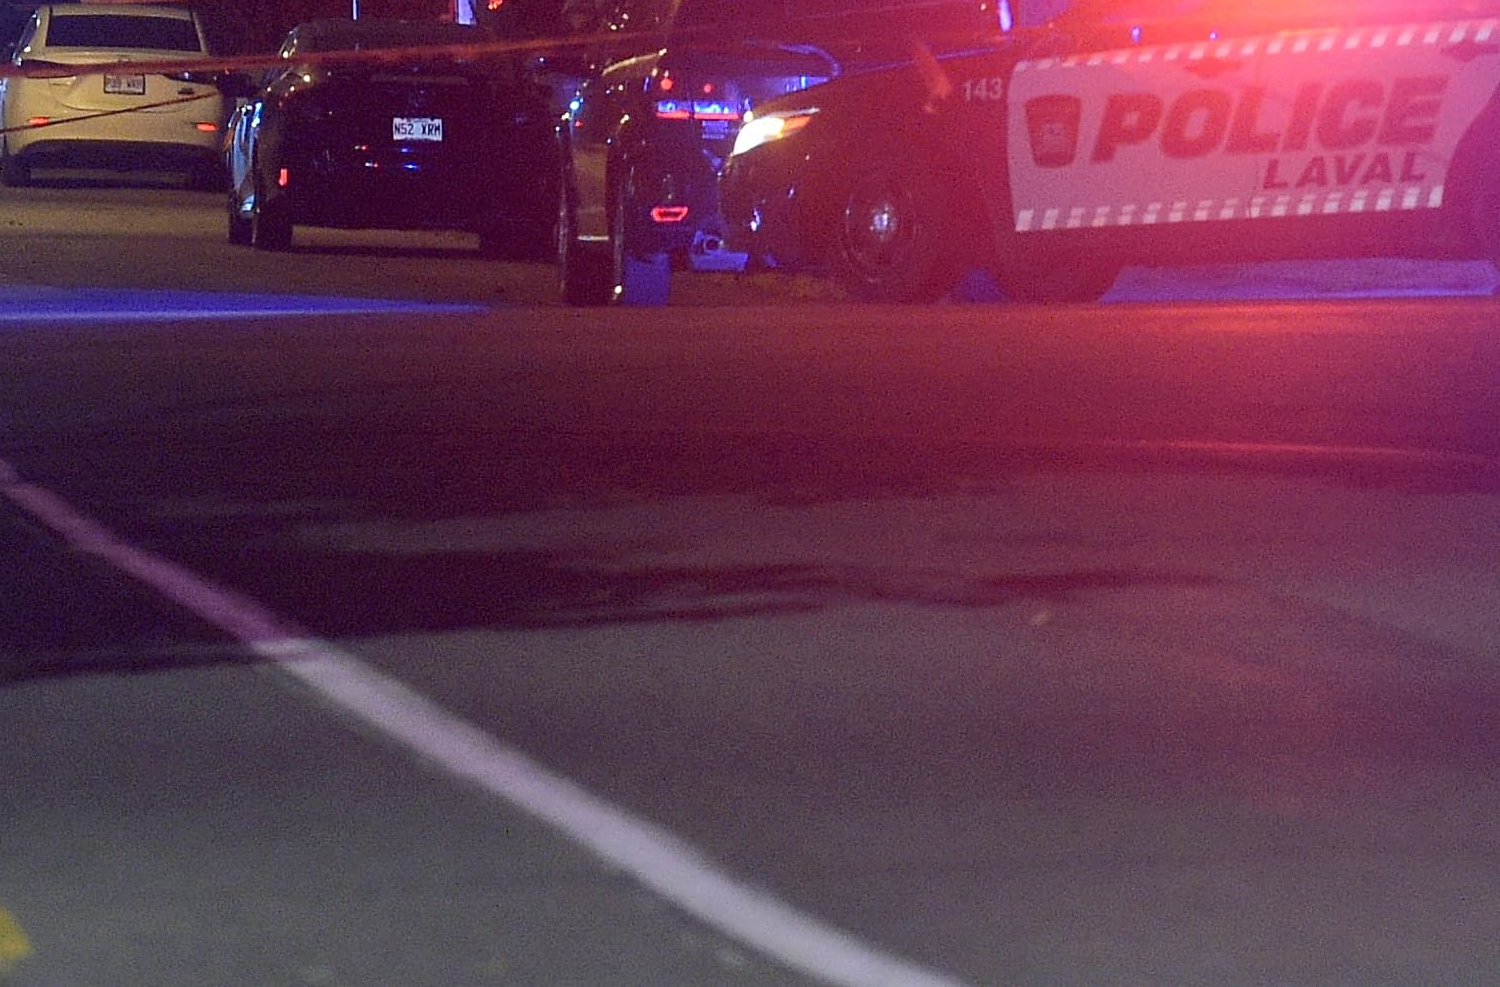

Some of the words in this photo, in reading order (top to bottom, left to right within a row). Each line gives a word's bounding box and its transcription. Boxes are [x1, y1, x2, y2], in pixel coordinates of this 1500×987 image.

[962, 78, 1003, 103] 143
[1091, 75, 1449, 164] POLICE
[1262, 152, 1427, 190] LAVAL
